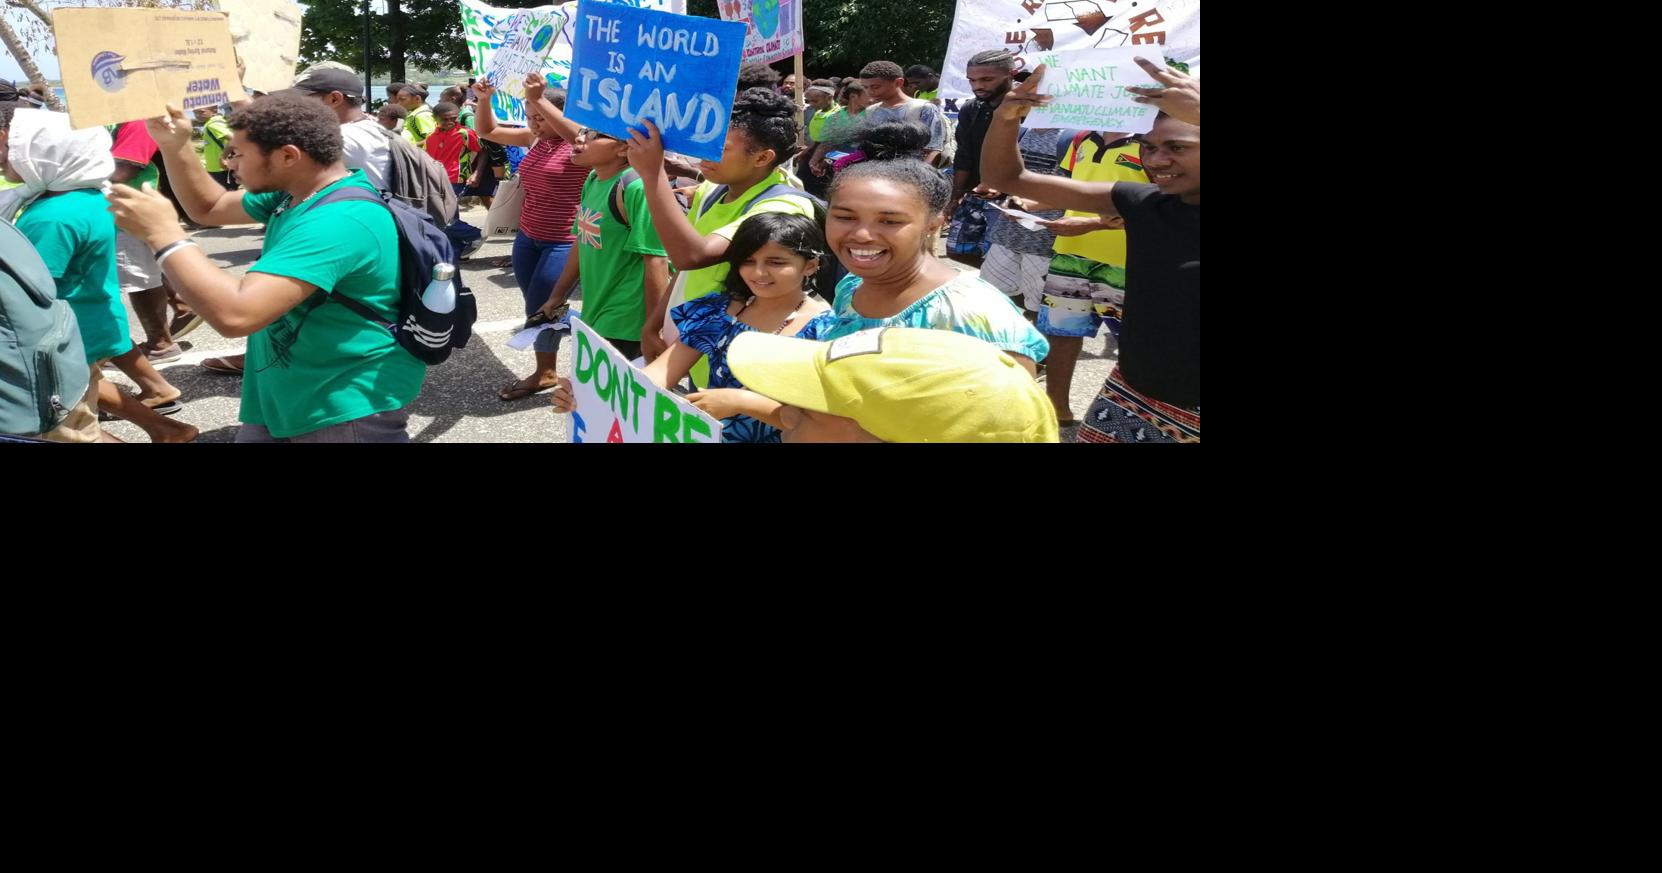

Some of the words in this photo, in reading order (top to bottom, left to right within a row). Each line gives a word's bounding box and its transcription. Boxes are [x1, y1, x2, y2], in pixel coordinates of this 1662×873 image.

[586, 15, 622, 43] THE
[638, 24, 719, 57] WORLD
[606, 51, 625, 74] IS
[639, 60, 676, 83] AN
[1038, 54, 1062, 69] WE
[1066, 66, 1118, 82] WANT
[187, 78, 220, 93] Water
[1047, 82, 1104, 98] CLIMATE
[183, 91, 229, 109] Vanuatu
[577, 67, 725, 143] ISLAND
